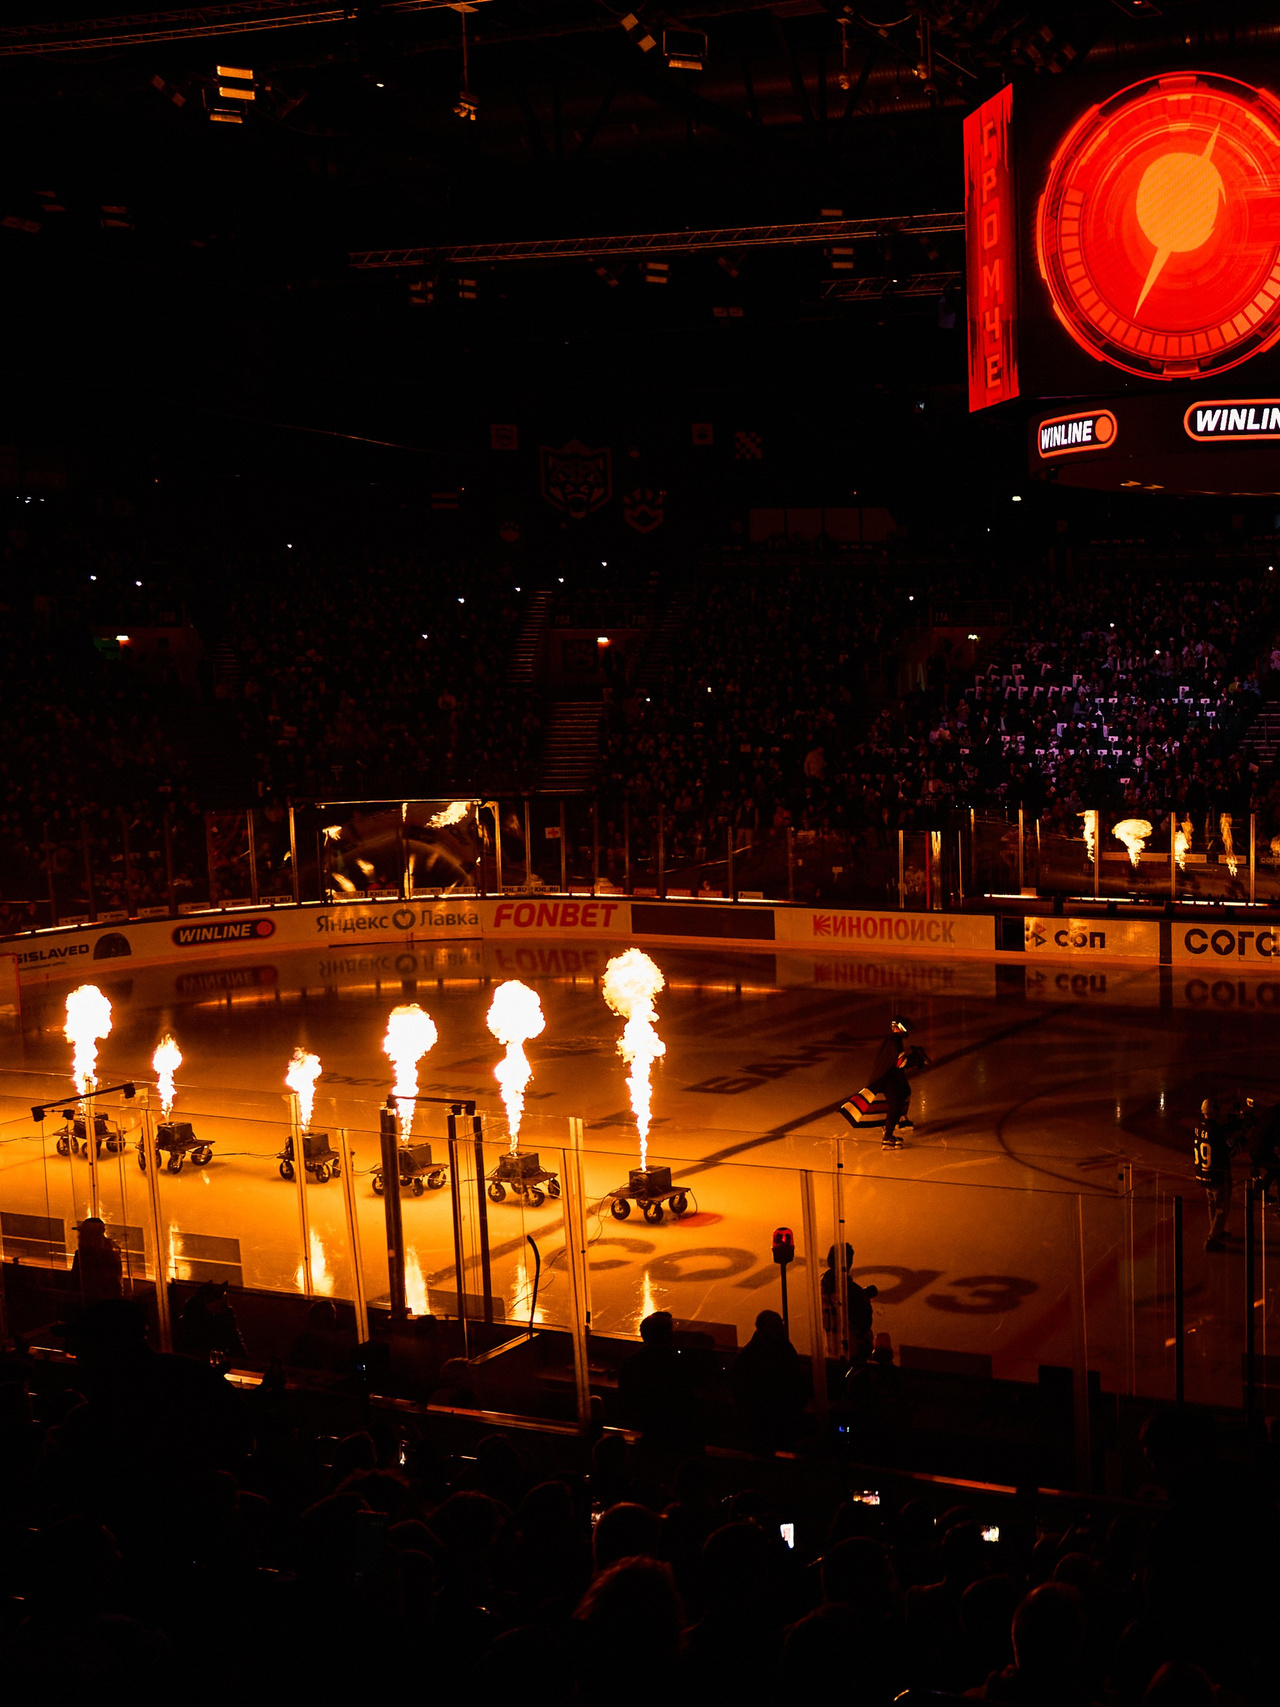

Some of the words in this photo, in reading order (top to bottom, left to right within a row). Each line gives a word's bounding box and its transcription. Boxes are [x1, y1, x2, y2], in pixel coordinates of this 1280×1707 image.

[982, 120, 1001, 388] ГРОМЧЕ
[1041, 420, 1093, 449] WINLINE
[316, 915, 389, 933] Яндекс
[419, 910, 479, 927] Лавка
[493, 903, 618, 927] FONBET
[179, 923, 251, 943] WINLINE
[813, 914, 955, 943] КИНОПОИСК
